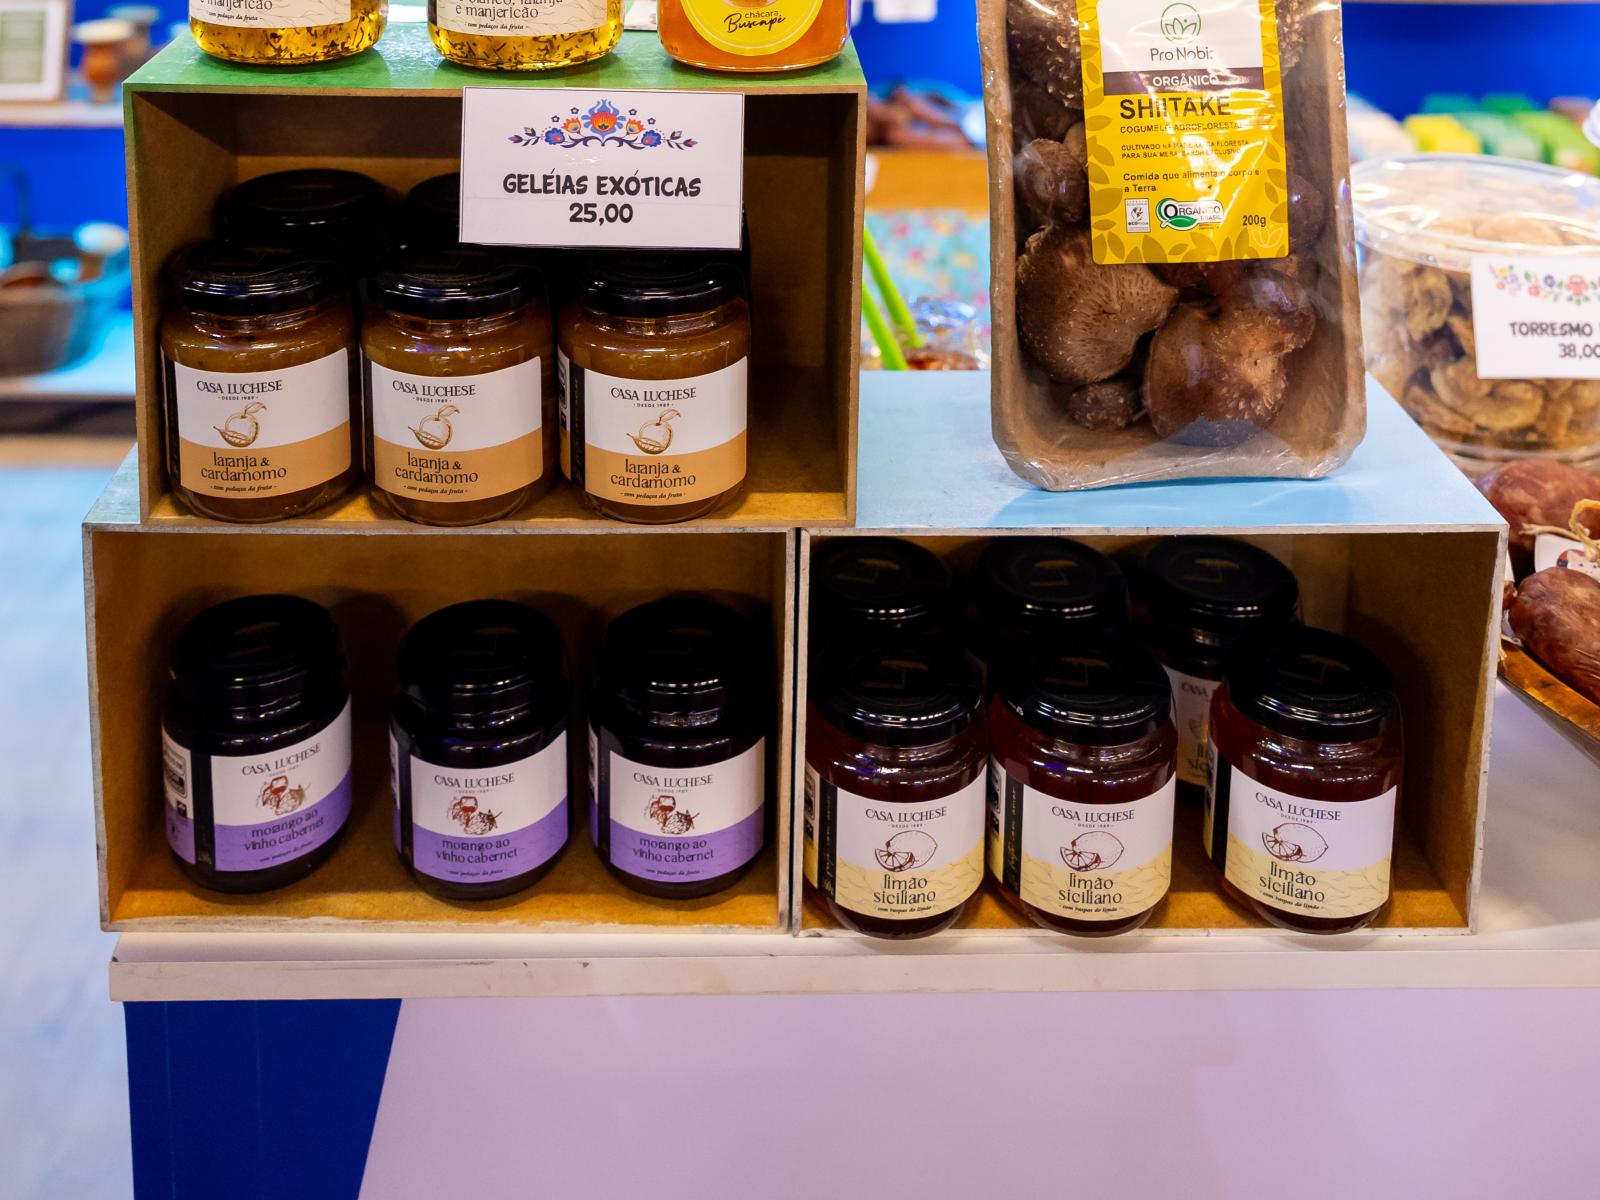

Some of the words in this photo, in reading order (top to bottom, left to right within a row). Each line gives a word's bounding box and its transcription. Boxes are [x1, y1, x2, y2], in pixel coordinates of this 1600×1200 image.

[455, 6, 462, 15] e
[466, 5, 539, 22] manjericão
[744, 10, 780, 19] chácara
[723, 12, 787, 33] Buscapé
[1150, 47, 1174, 62] Pro
[1152, 72, 1219, 87] ORGÂNICO
[1119, 96, 1231, 120] SHIITAKE
[1121, 143, 1160, 151] CULTIVADO
[502, 168, 588, 195] GELÉIAS
[596, 169, 702, 197] EXÓTICAS
[1123, 172, 1160, 181] Comida
[1162, 172, 1179, 182] que
[1182, 170, 1218, 179] alimenta
[1228, 168, 1253, 178] corpo
[1133, 183, 1159, 193] Terra.
[569, 202, 634, 226] 25,00
[1242, 214, 1267, 228] 200g
[1509, 321, 1593, 337] TORRESMO
[1558, 343, 1600, 360] 38,00
[196, 380, 224, 394] CASA
[227, 379, 283, 395] LUCHESE
[392, 379, 418, 395] CASA
[422, 384, 476, 397] LUCHESE
[610, 387, 640, 401] CASA
[644, 387, 697, 402] LUCHESE
[213, 451, 257, 471] laranja
[260, 457, 270, 467] &
[407, 451, 450, 474] laranja
[452, 460, 462, 470] &
[625, 458, 669, 478] laranja
[672, 464, 681, 474] &
[200, 466, 287, 482] cardamomo
[395, 466, 479, 484] cardamomo
[610, 474, 697, 489] cardamomo
[241, 763, 271, 776] CASA
[274, 742, 321, 770] LUCHESE
[434, 774, 461, 788] CASA
[464, 772, 515, 789] LUCHESE
[633, 772, 660, 788] CASA
[663, 773, 714, 788] LUCHESE
[865, 807, 895, 823] CASA
[898, 806, 948, 823] LUCHESE
[1051, 805, 1081, 822] CASA
[1085, 809, 1135, 823] LUCHESE
[1255, 791, 1284, 812] CASA
[1287, 803, 1342, 821] LUCHESE
[251, 814, 304, 838] morango
[304, 808, 318, 822] ao
[244, 834, 277, 851] vinho
[278, 816, 325, 846] cabernet
[441, 838, 494, 853] morango
[495, 838, 510, 850] ao
[639, 837, 690, 852] morango
[692, 838, 708, 850] ao
[435, 850, 466, 864] vinho
[467, 847, 518, 864] cabernet
[632, 847, 663, 863] vinho
[664, 847, 714, 864] cabernet
[883, 873, 928, 890] limão
[1069, 872, 1114, 890] limão
[1269, 860, 1317, 887] limão
[873, 889, 936, 906] siciliano
[1058, 889, 1122, 905] siciliano
[1259, 875, 1326, 903] siciliano
